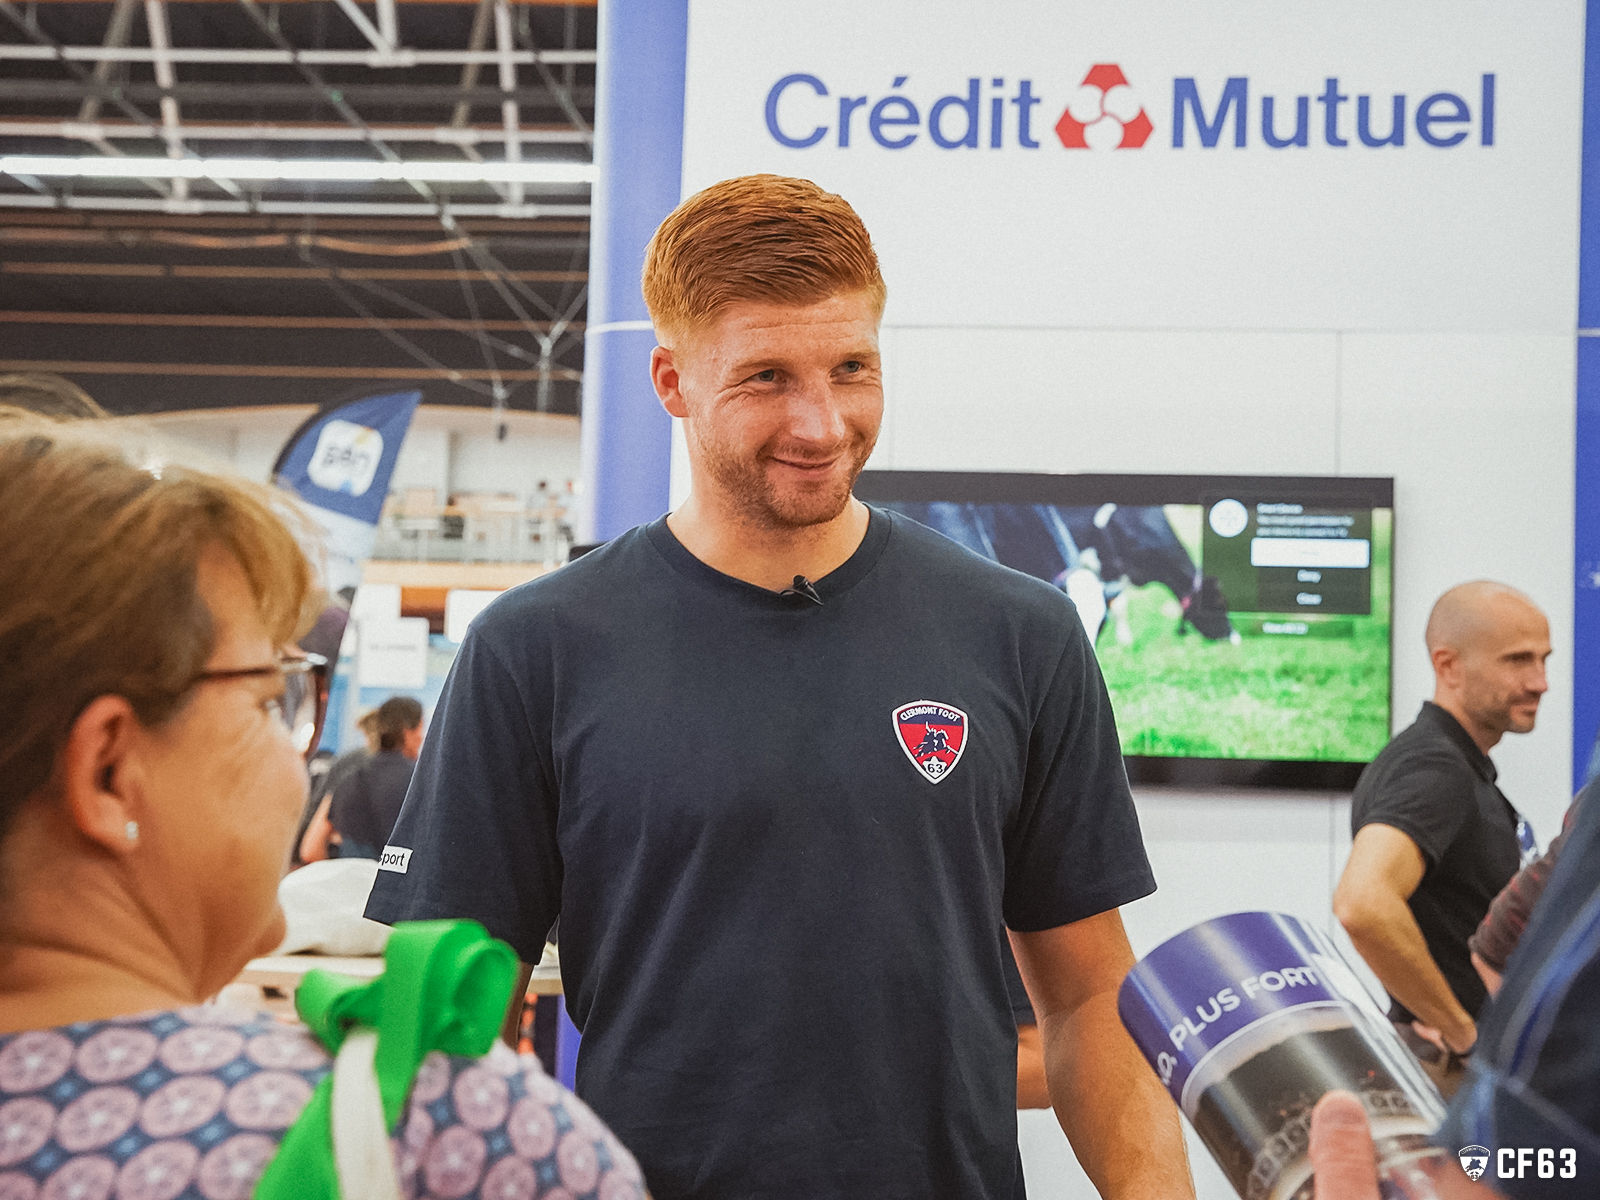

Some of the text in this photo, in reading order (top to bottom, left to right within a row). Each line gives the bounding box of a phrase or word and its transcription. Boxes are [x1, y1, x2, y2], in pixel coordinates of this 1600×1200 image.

[764, 73, 1497, 150] Crédit Mutuel
[900, 706, 960, 722] CLERMONT FOOT
[927, 763, 944, 774] 63
[1169, 988, 1242, 1051] PLUS
